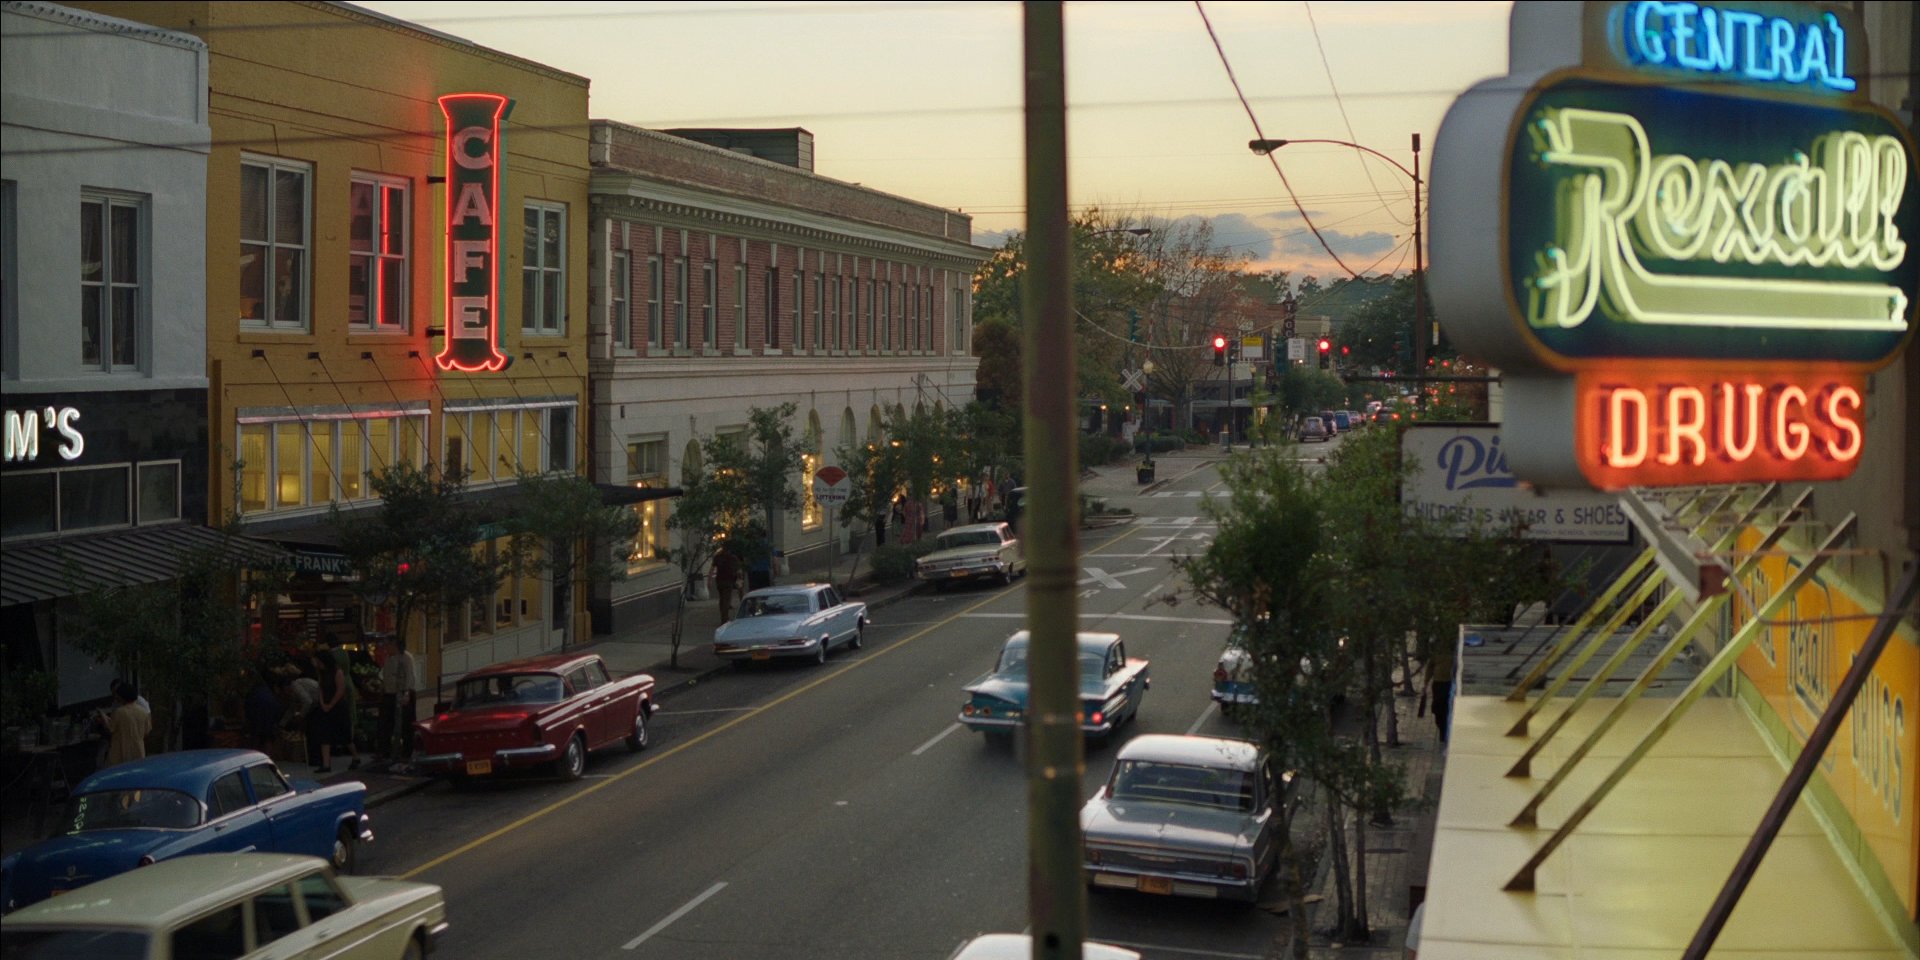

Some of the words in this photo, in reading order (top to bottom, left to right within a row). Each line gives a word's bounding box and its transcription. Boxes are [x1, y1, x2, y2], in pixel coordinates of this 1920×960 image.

[1628, 1, 1857, 92] CENTRAL
[451, 125, 494, 342] CAFE
[1531, 106, 1909, 331] Rexall
[4, 405, 84, 462] M'S
[1602, 382, 1863, 468] DRUGS
[1402, 500, 1493, 523] CHILDRENS
[1554, 508, 1565, 524] &
[1574, 504, 1625, 525] SHOES
